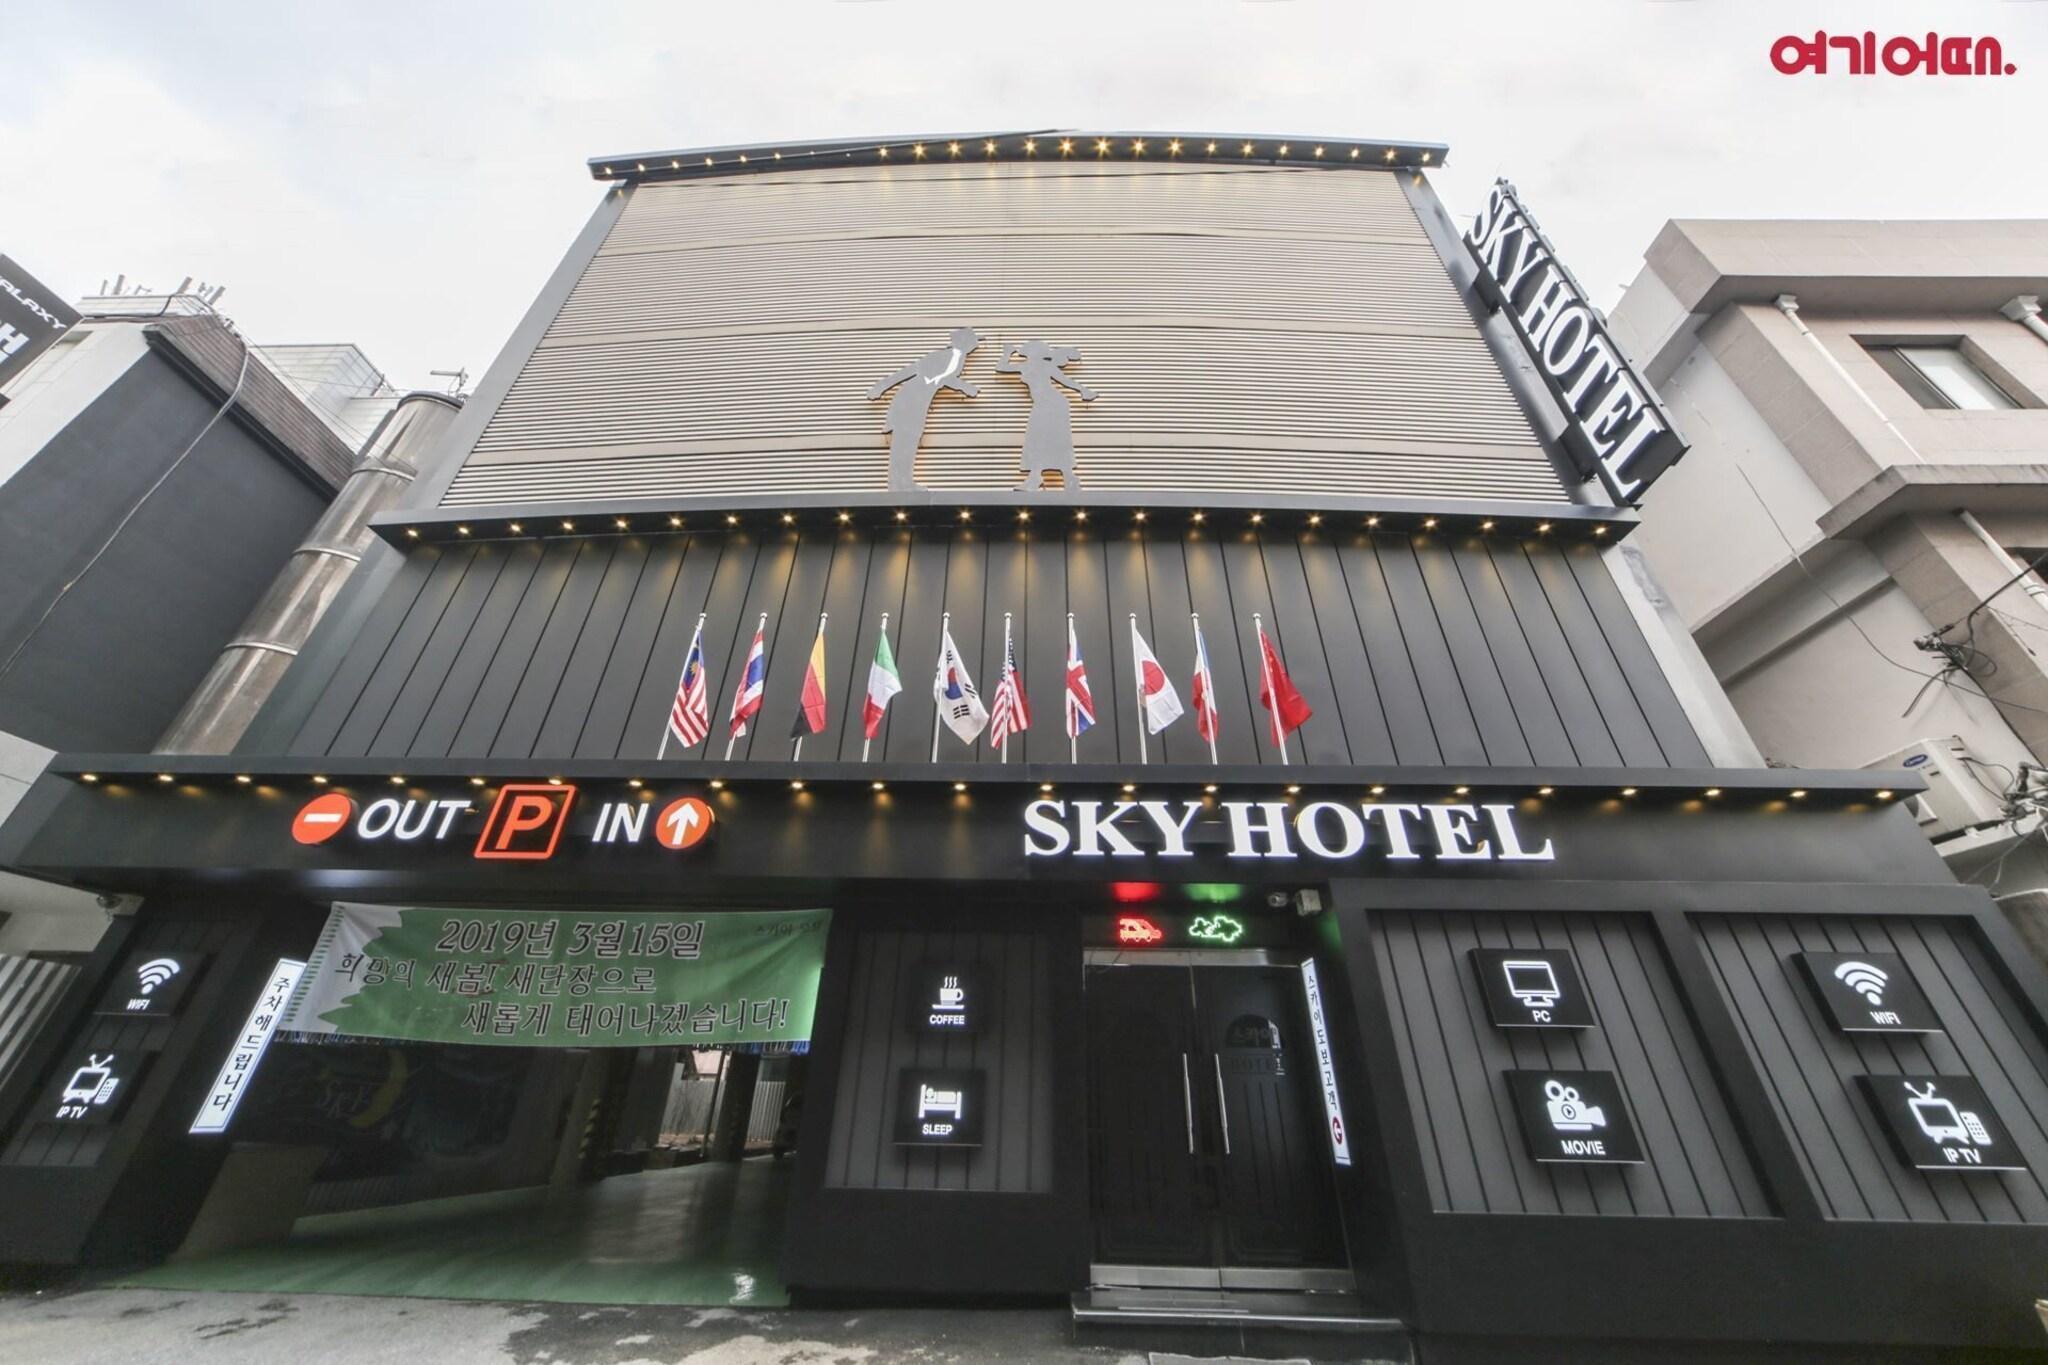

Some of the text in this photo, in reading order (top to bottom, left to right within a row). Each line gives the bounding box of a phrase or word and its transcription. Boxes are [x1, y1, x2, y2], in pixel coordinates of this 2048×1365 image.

[0, 275, 67, 329] ALAXY
[1469, 184, 1666, 498] SKY HOTEL
[356, 795, 649, 850] OUT P IN
[1023, 799, 1555, 860] SKY HOTEL
[436, 920, 560, 957] 2019년
[335, 952, 657, 997] 희망의 새봄! 새단장으로
[127, 999, 151, 1011] WIFI
[461, 997, 790, 1036] 새롭게 태어나겠습니다!
[929, 1014, 965, 1025] COFFEE
[1532, 1010, 1551, 1023] PC
[1869, 1010, 1902, 1025] WIFI
[212, 976, 291, 1112] 주차해드립니다
[922, 1123, 953, 1136] SLEEP
[1561, 1140, 1607, 1156] MOVIE
